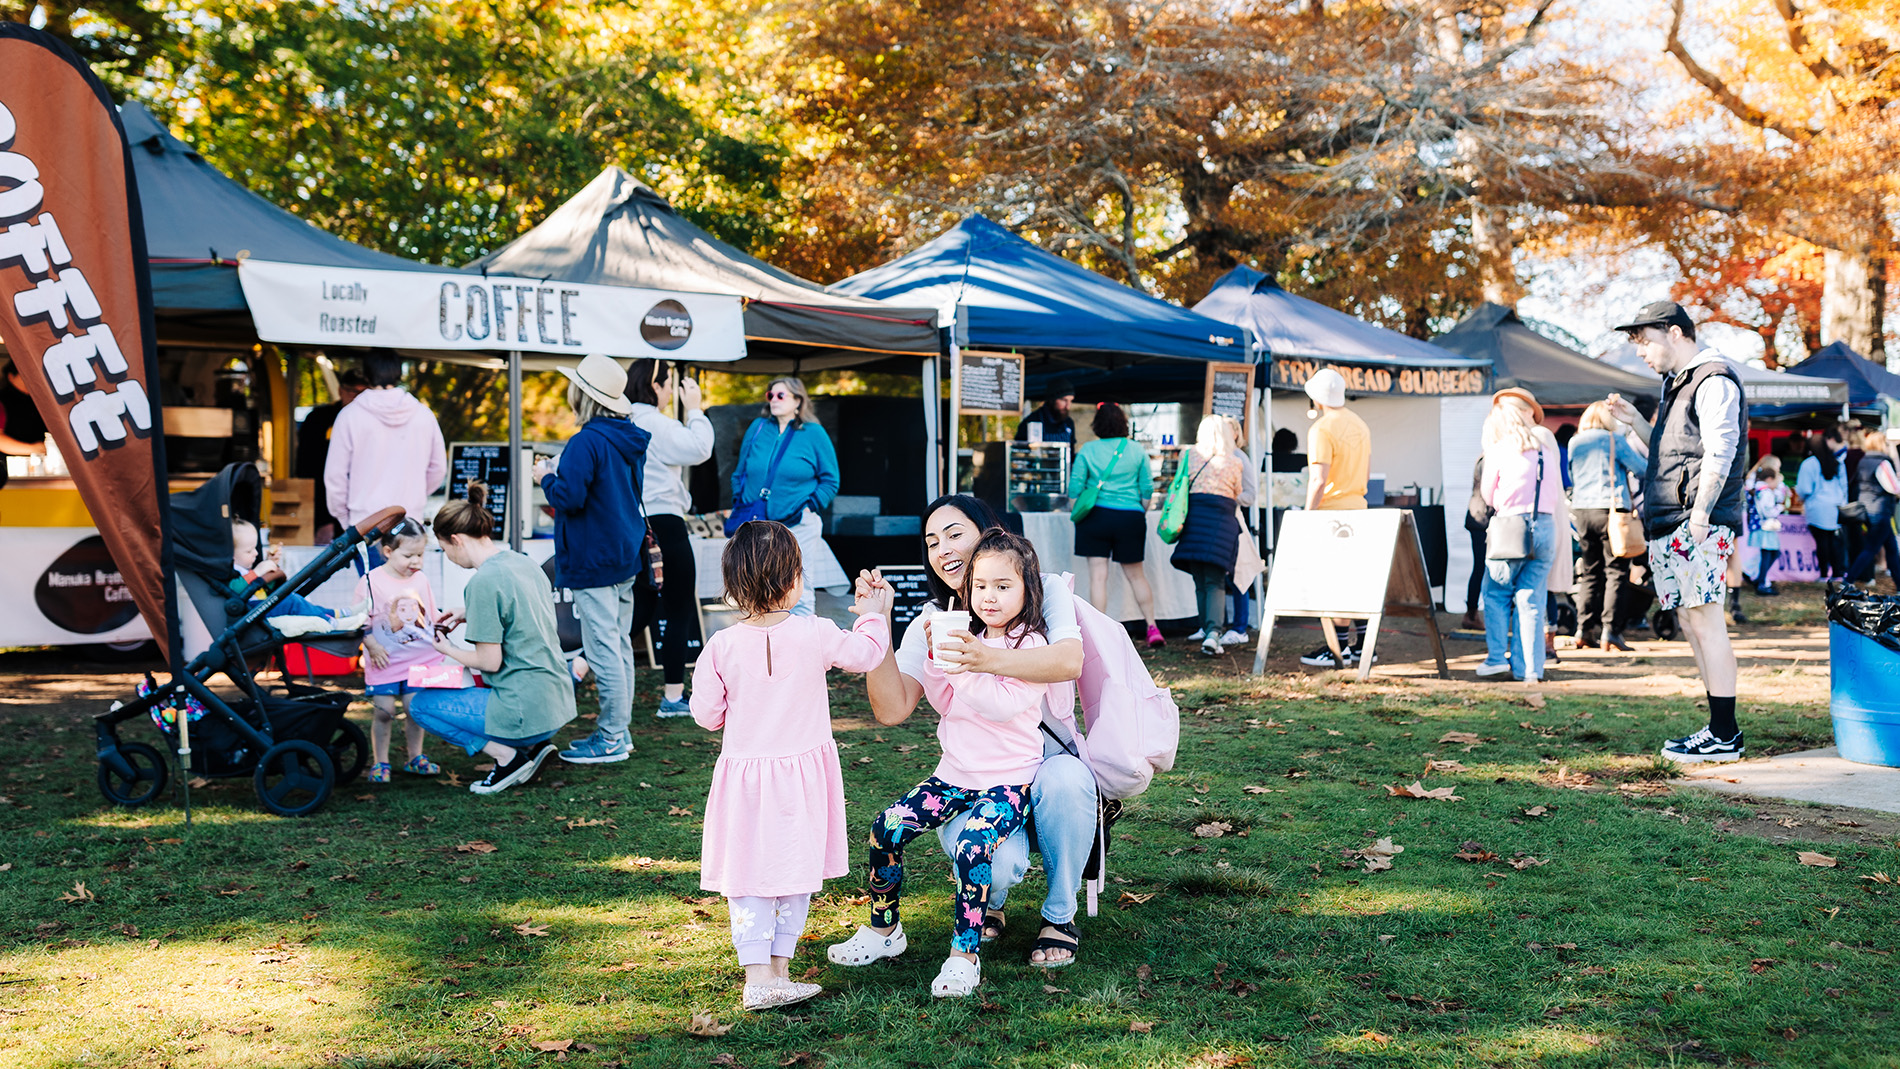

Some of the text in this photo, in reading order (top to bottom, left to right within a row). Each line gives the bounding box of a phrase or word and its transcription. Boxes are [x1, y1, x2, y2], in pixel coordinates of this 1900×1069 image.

[0, 102, 152, 456] OFFEE
[322, 280, 368, 305] Locally
[320, 312, 377, 334] Roasted
[439, 281, 582, 347] COFFEE
[1279, 360, 1320, 385] FRY
[1399, 369, 1483, 394] BURGERS
[48, 571, 92, 587] Manuka
